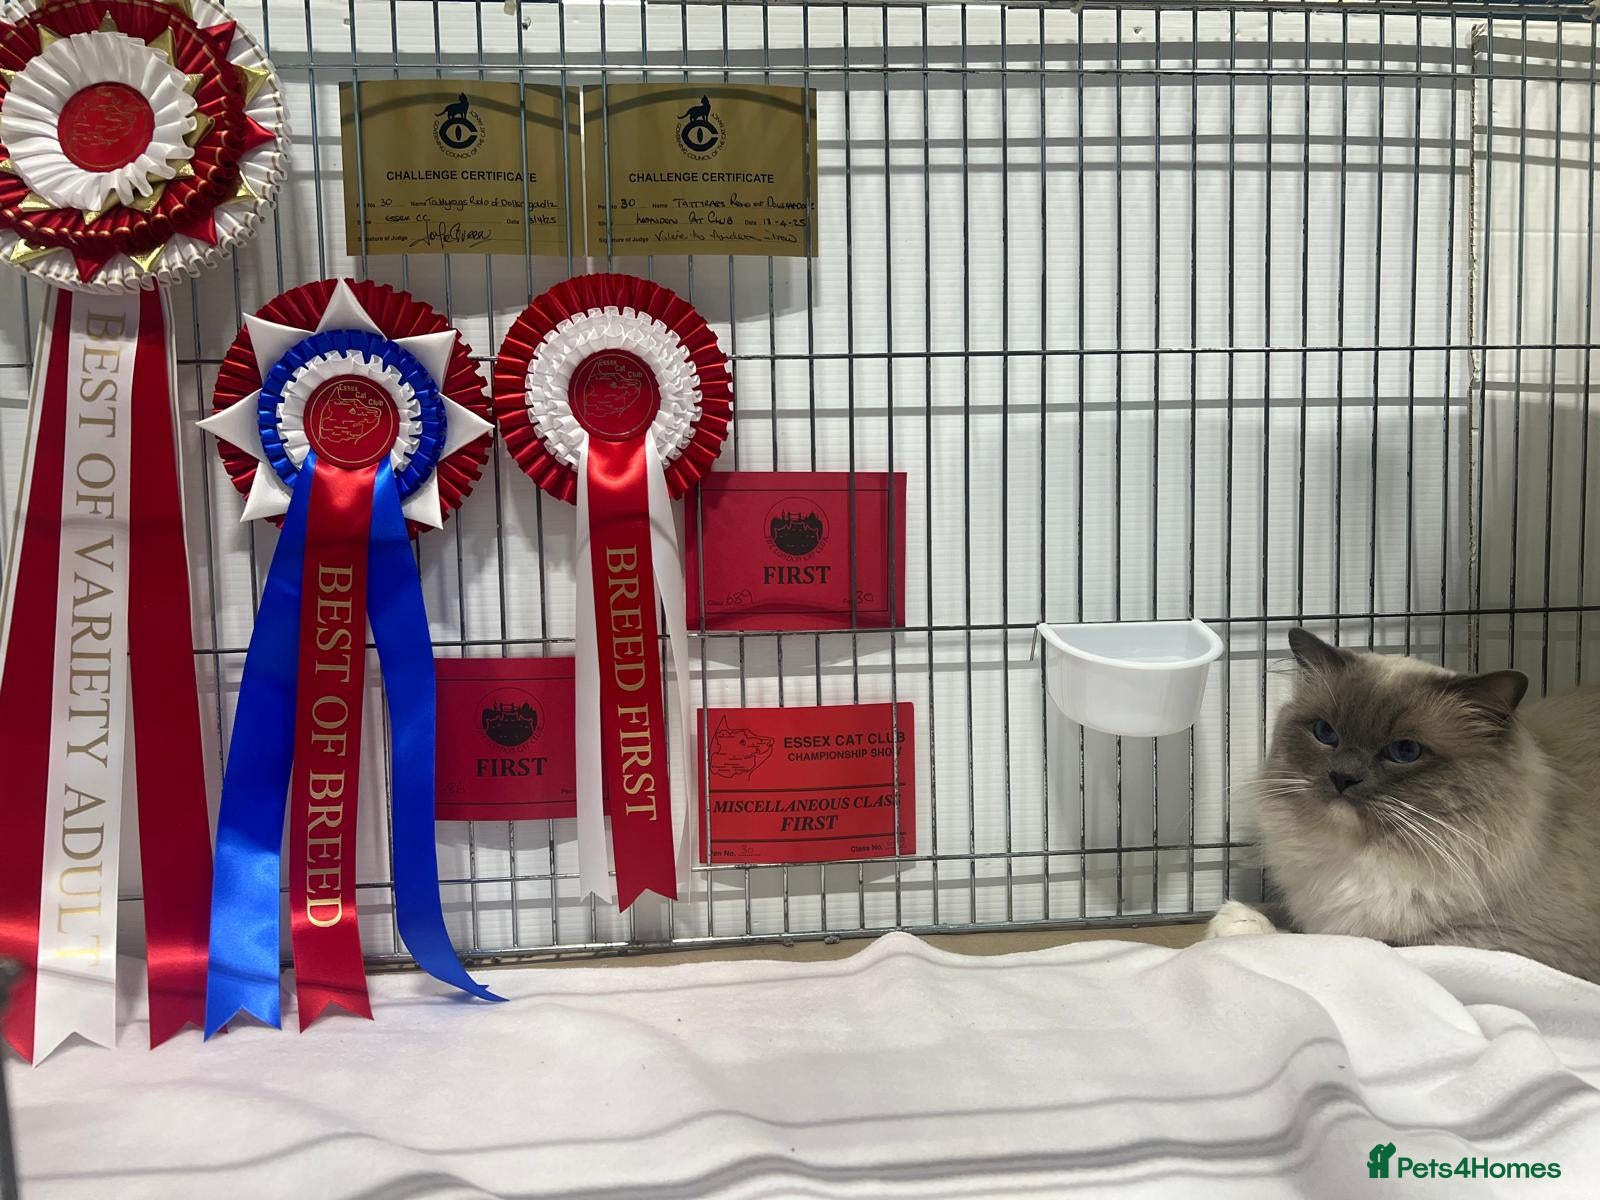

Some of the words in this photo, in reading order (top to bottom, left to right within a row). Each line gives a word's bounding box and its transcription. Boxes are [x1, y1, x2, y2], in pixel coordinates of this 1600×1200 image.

[386, 170, 457, 181] CHALLENGE
[628, 172, 699, 183] CHALLENGE
[701, 172, 775, 184] CERTIFICATE
[620, 198, 636, 209] 30
[78, 308, 126, 438] BEST
[76, 453, 115, 519] OF
[763, 566, 831, 585] FIRST
[315, 562, 353, 683] BEST
[606, 544, 647, 692] BREED
[66, 535, 114, 768] VARIETY
[311, 695, 349, 757] OF
[783, 735, 831, 749] ESSEX
[835, 734, 863, 747] CAT
[476, 757, 548, 777] FIRST
[617, 702, 657, 822] FIRST
[788, 749, 868, 762] CHAMPIONSHIP
[713, 796, 850, 814] MISCELLANEOUS
[780, 815, 838, 832] FIRST
[306, 769, 345, 928] BREED
[56, 784, 107, 968] ADULT
